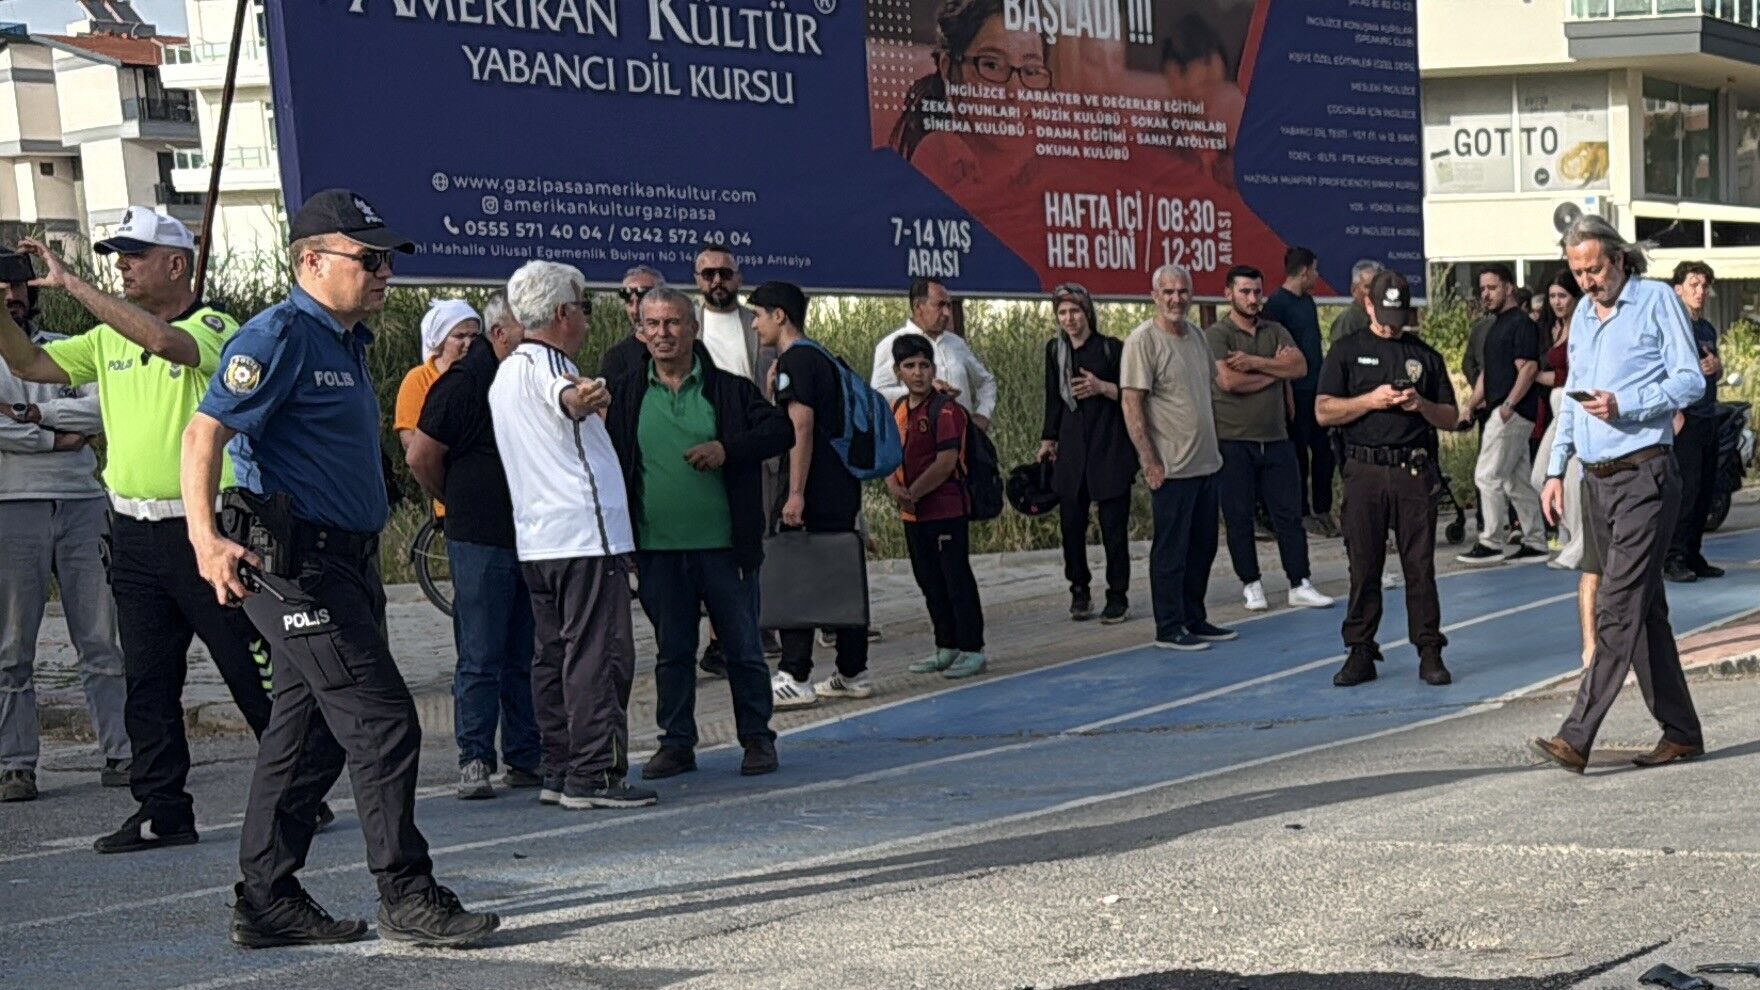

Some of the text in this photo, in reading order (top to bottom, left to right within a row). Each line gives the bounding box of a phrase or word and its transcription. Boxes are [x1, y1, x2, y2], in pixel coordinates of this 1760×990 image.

[349, 0, 619, 38] MERIKAN
[1004, 0, 1121, 45] BAŞLADI
[462, 45, 795, 104] YABANCI DİL KURSU
[945, 81, 1006, 100] İNGİLİZCE
[1017, 89, 1080, 106] KARAKTER
[1084, 94, 1100, 107] VE
[1102, 92, 1161, 112] DEĞERLER
[922, 99, 952, 113] ZEKA
[958, 102, 1020, 118] OYUNLARI
[1032, 104, 1070, 122] MÜZİK
[1074, 108, 1121, 125] KULÜBÜ
[1131, 114, 1170, 130] SOKAK
[1173, 115, 1227, 133] OYUNLARI
[924, 116, 971, 133] SİNEMA
[974, 119, 1025, 137] KULÜBÜ
[1036, 126, 1080, 141] DRAMA
[1136, 131, 1173, 147] SANAT
[1036, 142, 1130, 161] OKUMA KULÜBÜ
[452, 175, 757, 203] www.gazipasaamerikankultur.com
[504, 200, 716, 222] amerikankulturgazipasa
[1045, 189, 1143, 238] HAFTA İÇİ
[1157, 198, 1215, 234] 08:30
[432, 242, 486, 255] Mahalle
[465, 220, 509, 237] 0555
[515, 222, 543, 239] 571
[550, 224, 573, 239] 40
[579, 225, 602, 240] 04
[620, 226, 663, 243] 0242
[668, 228, 698, 244] 572
[703, 230, 724, 246] 40
[730, 231, 752, 246] 04
[891, 217, 971, 254] 7-14 YAŞ
[1047, 229, 1136, 270] HER GÜN
[1218, 211, 1232, 265] ARASI
[908, 249, 960, 278] ARASI
[1162, 237, 1217, 272] 12:30
